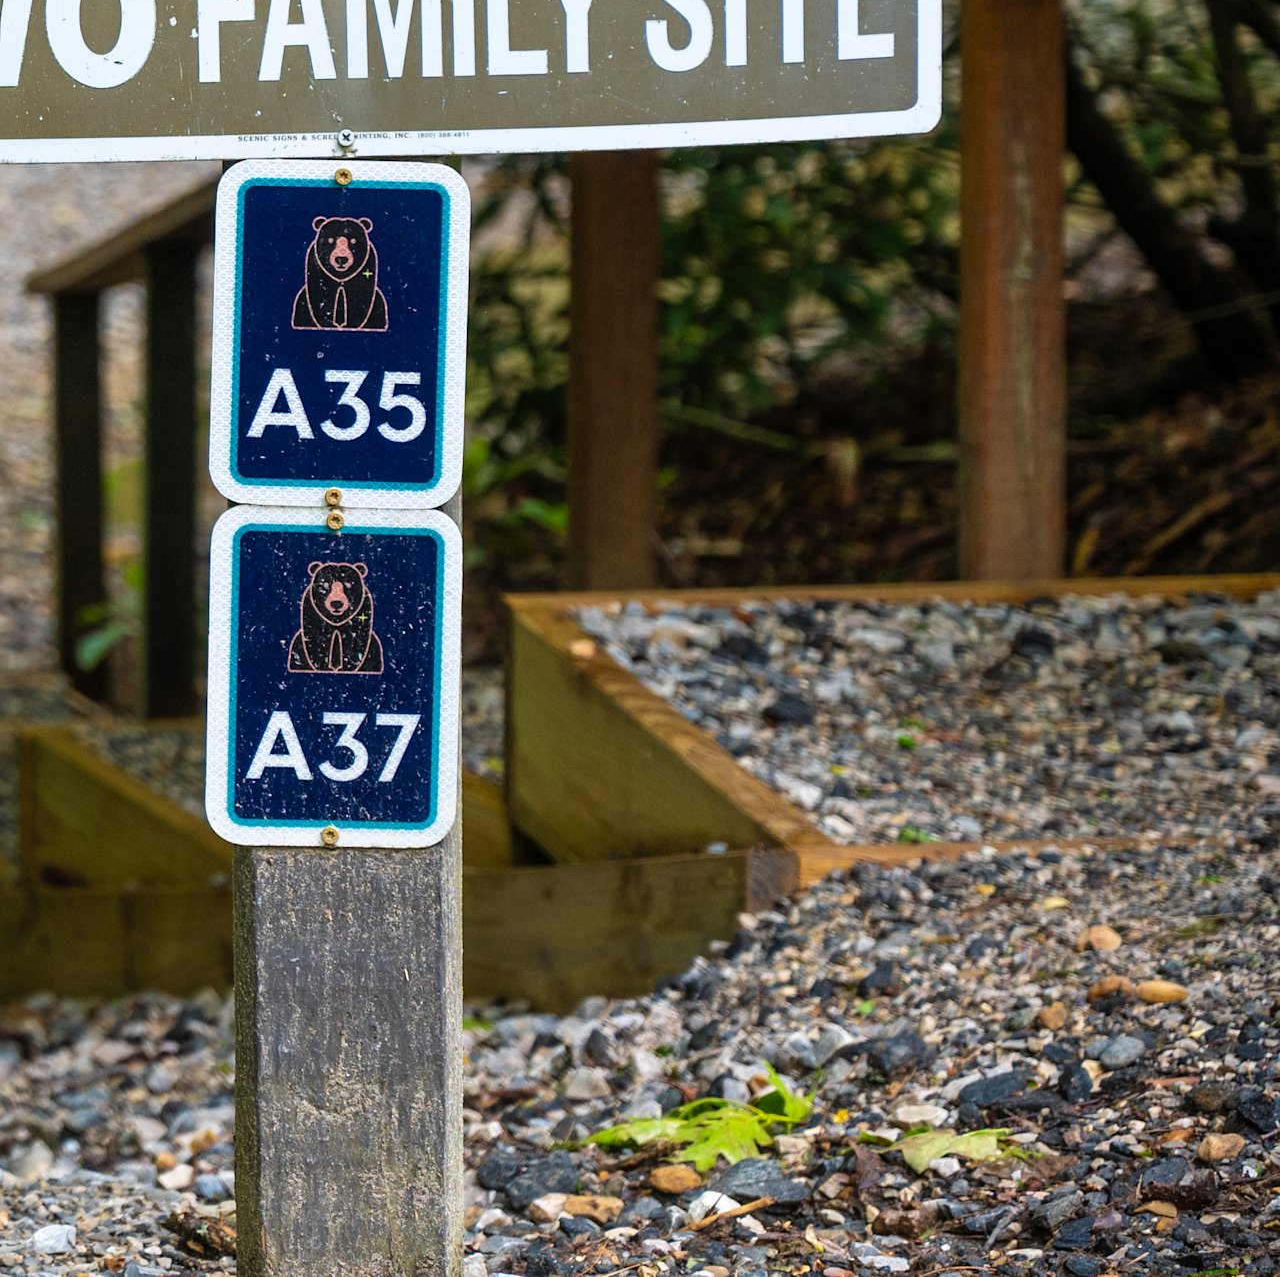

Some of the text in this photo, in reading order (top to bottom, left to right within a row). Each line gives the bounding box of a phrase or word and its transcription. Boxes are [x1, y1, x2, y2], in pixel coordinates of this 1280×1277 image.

[238, 134, 269, 142] SCENIC
[272, 134, 298, 142] SIGNS
[311, 133, 339, 141] SCREE
[246, 368, 428, 444] A35
[244, 710, 423, 784] A37
